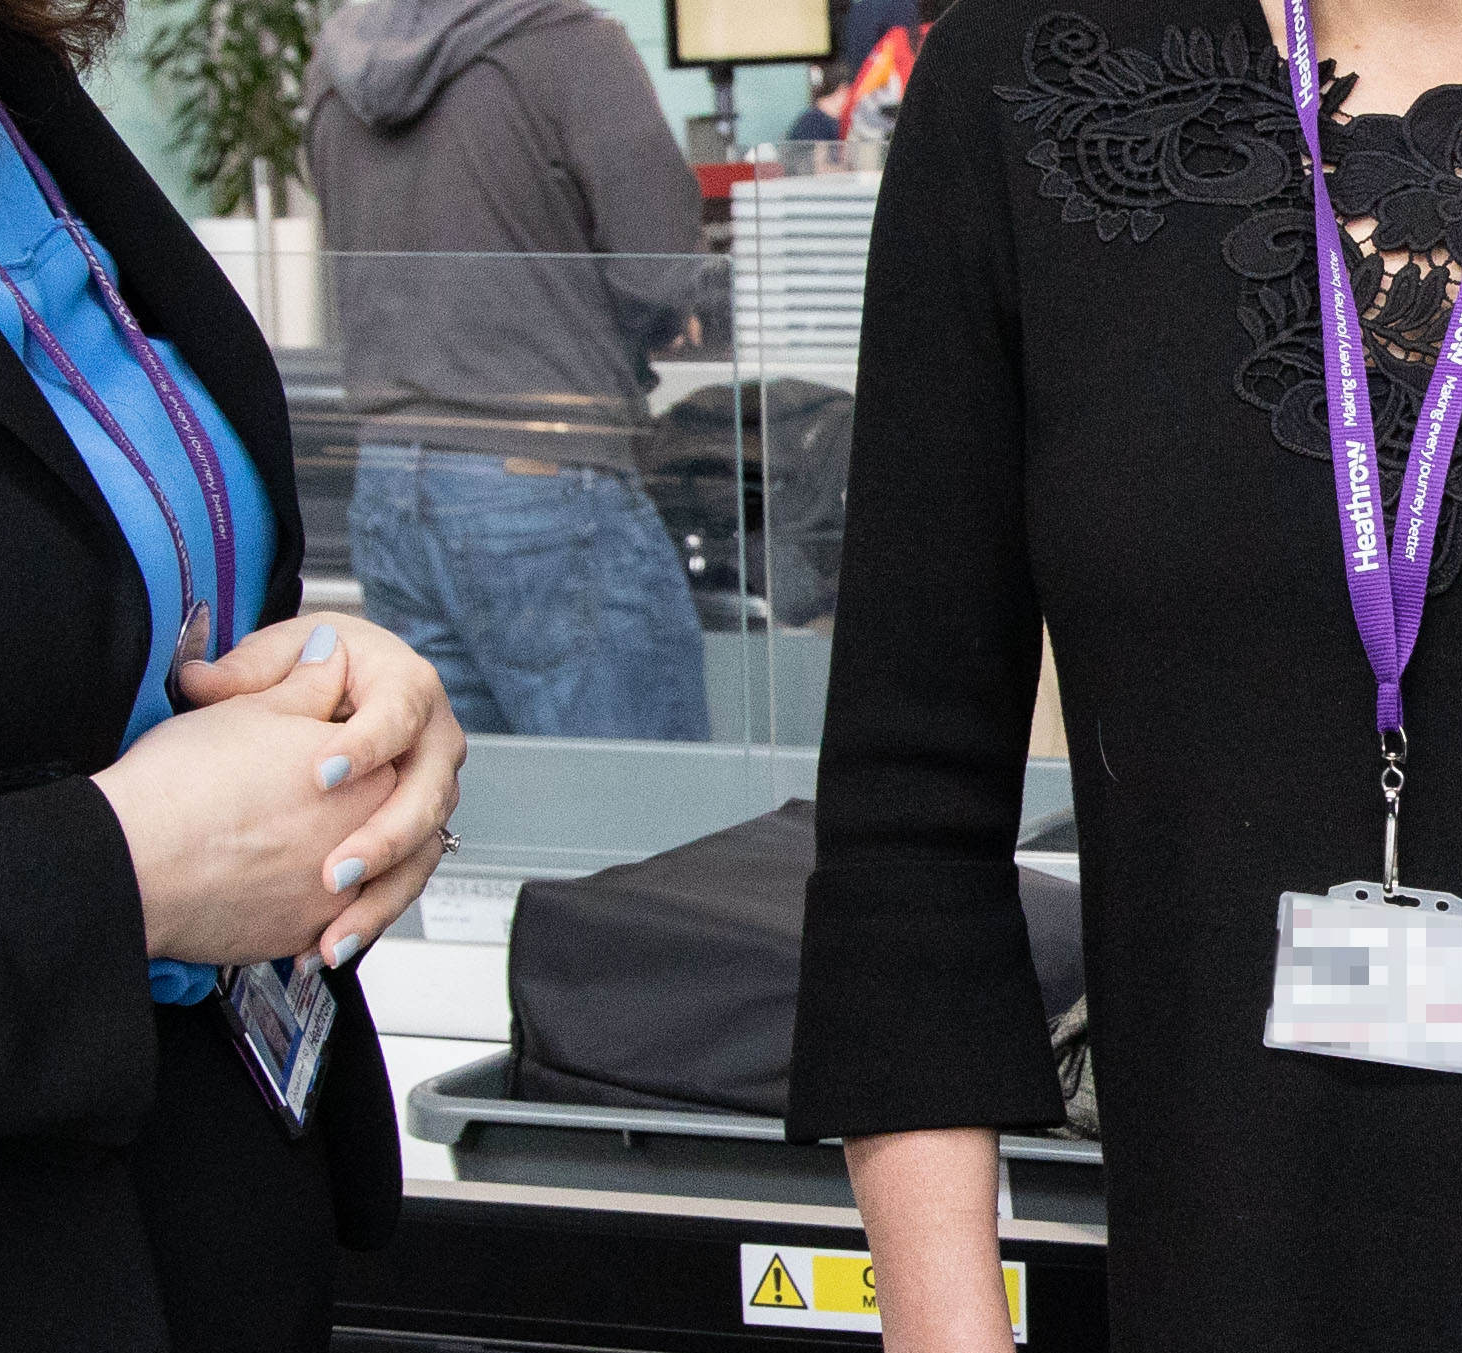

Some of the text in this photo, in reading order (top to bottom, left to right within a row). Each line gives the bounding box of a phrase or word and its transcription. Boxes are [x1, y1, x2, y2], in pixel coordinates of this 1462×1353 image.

[1329, 249, 1380, 574] Heathrow Making every journey better
[1429, 374, 1458, 423] Making
[141, 343, 170, 394] Making
[167, 391, 195, 436] every
[189, 435, 217, 492] journey
[211, 492, 228, 542] better
[1423, 420, 1442, 460] every
[1410, 457, 1433, 523] journey
[1404, 518, 1425, 563] better
